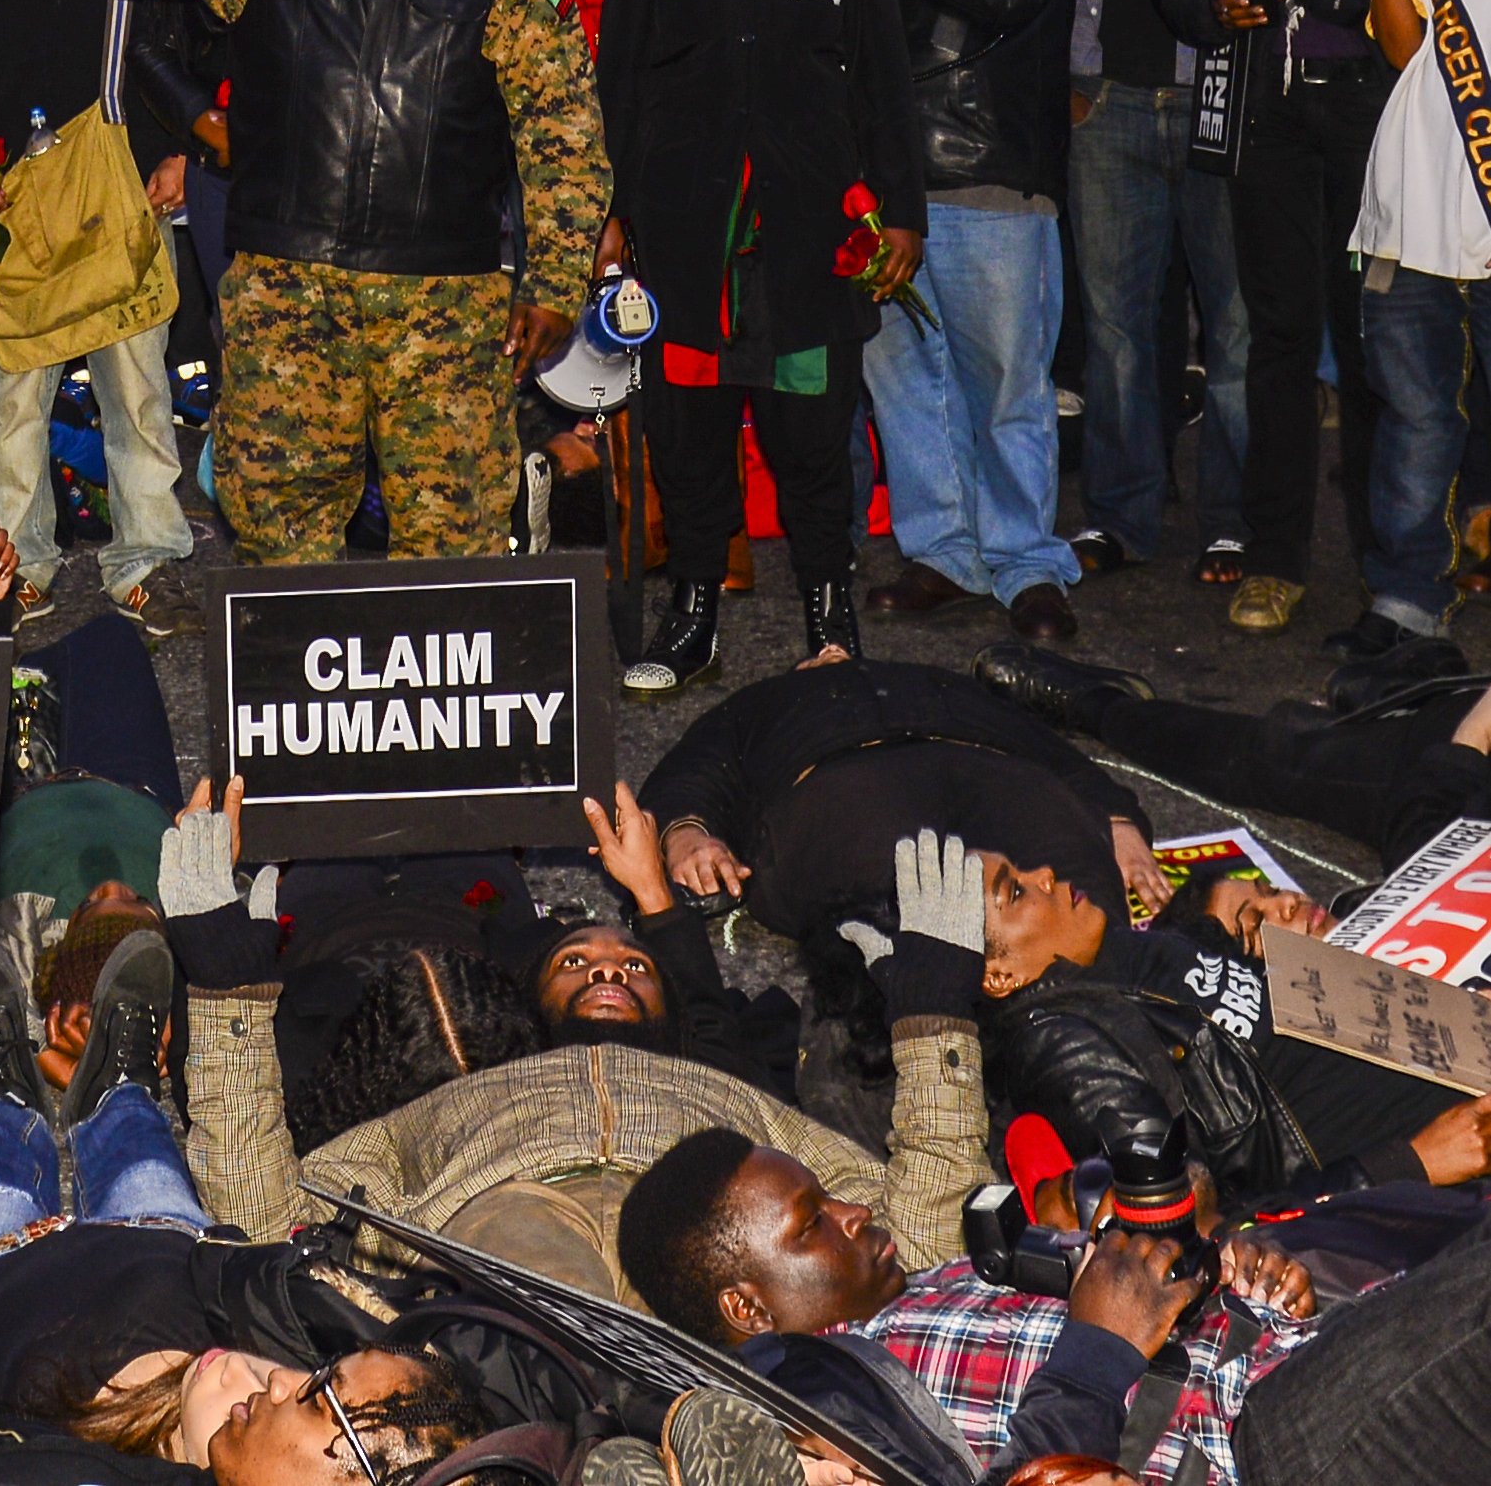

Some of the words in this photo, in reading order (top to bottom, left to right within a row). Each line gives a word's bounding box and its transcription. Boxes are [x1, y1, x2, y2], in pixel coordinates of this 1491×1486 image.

[303, 631, 493, 692] CLAIM
[237, 691, 564, 757] HUMANITY
[1383, 822, 1491, 893] EVERYWHERE
